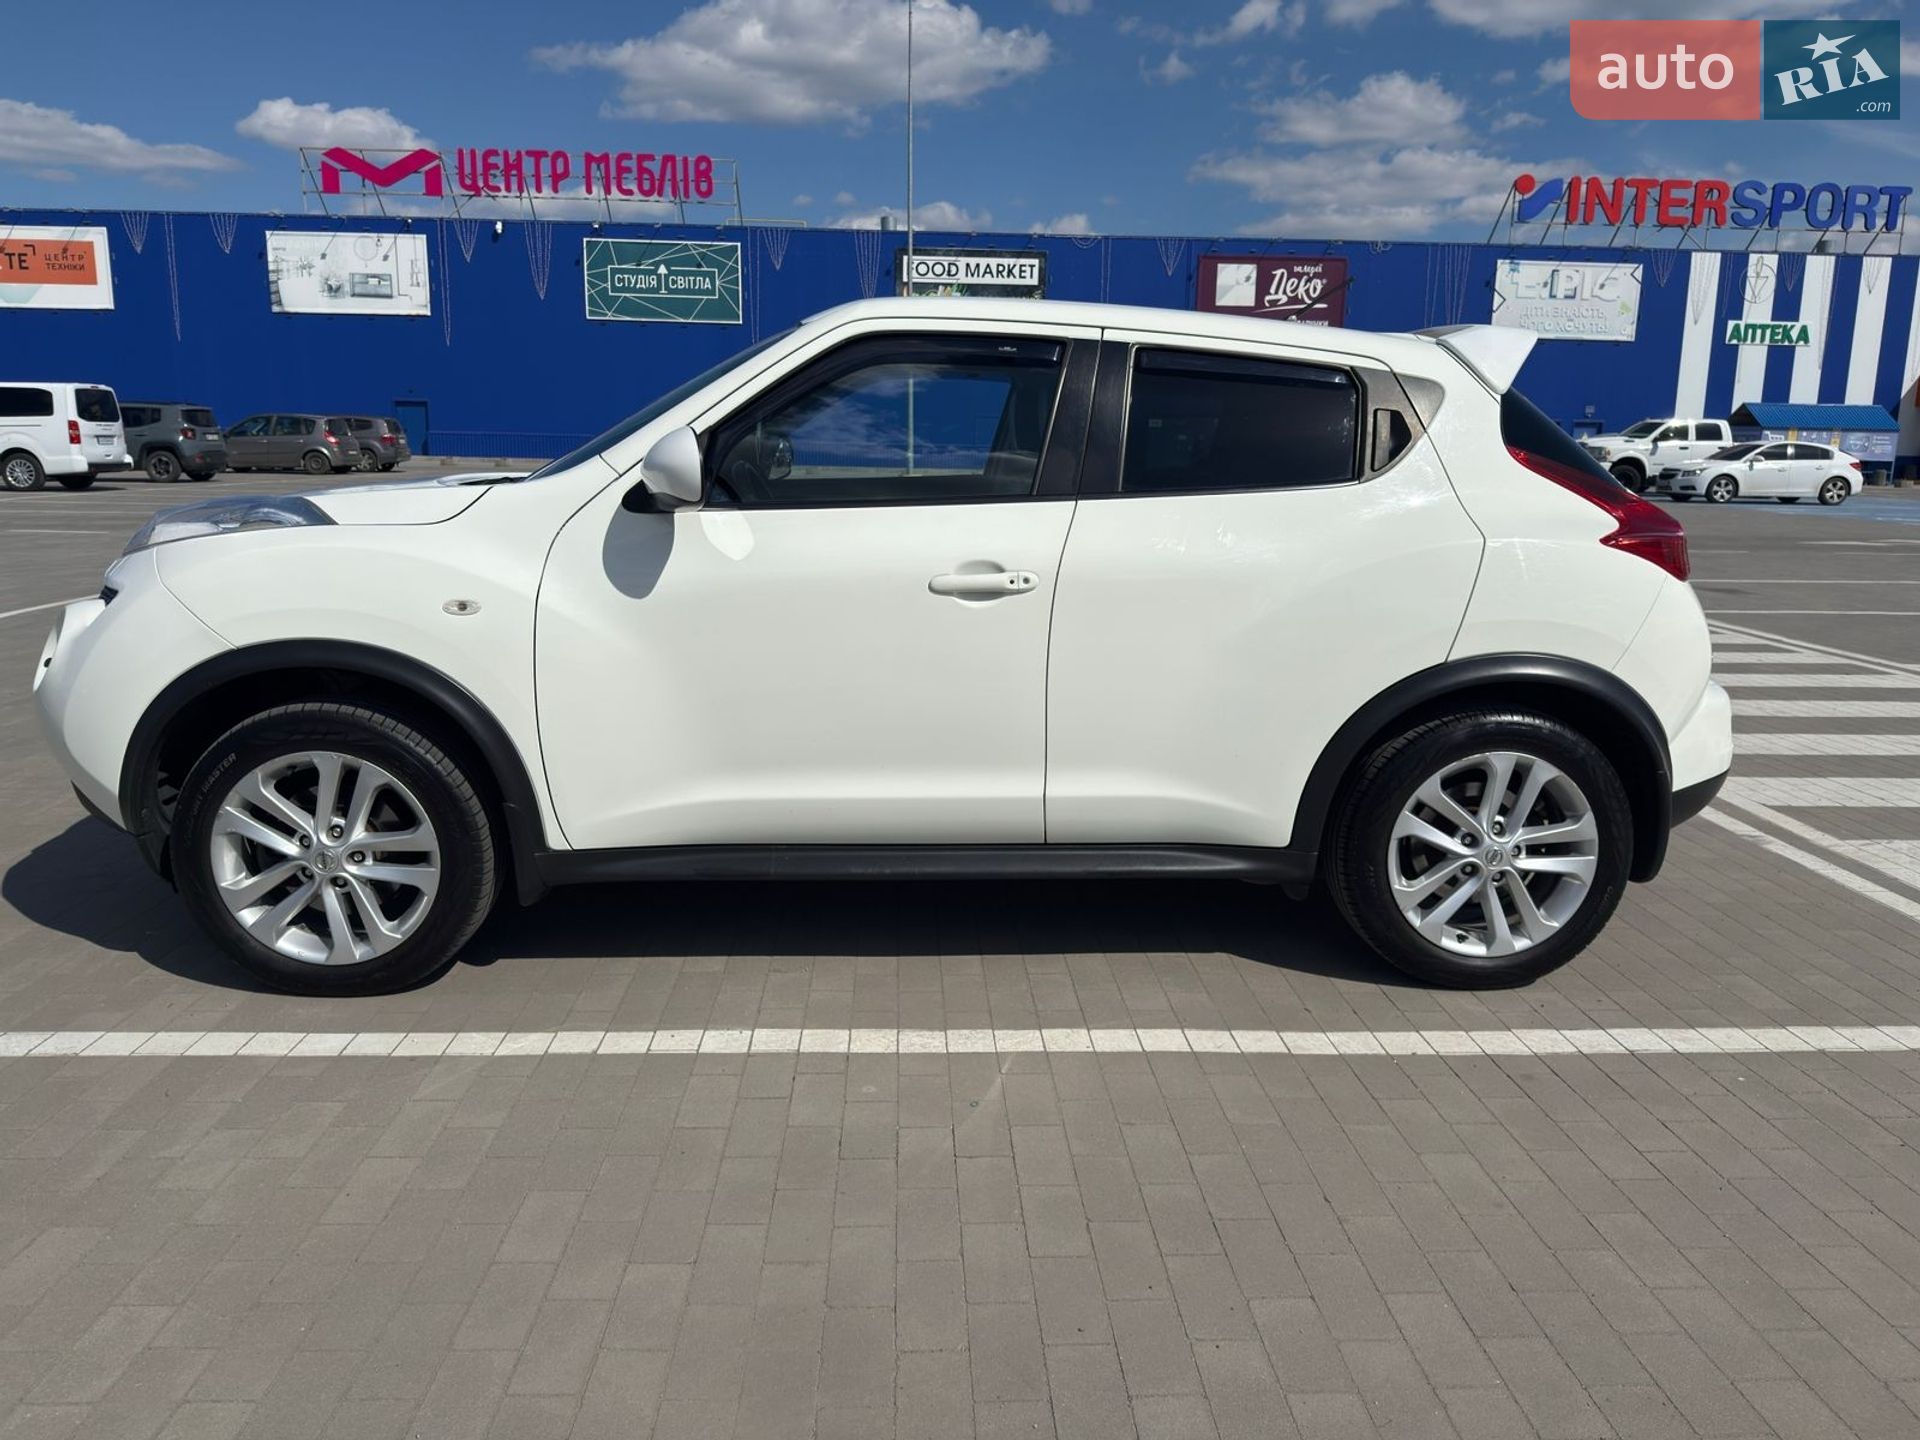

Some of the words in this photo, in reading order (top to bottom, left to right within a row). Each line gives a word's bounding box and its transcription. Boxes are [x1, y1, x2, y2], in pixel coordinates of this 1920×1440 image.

[457, 147, 570, 197] ЦЕНТР
[584, 151, 714, 199] МЕБЛІВ
[1566, 175, 1913, 232] INTERSPORT
[44, 252, 85, 262] ЦЕНТР
[45, 262, 86, 271] ТЕХНІКИ
[965, 262, 1036, 280] MARKET
[614, 274, 658, 289] СТУДІЯ
[668, 275, 712, 290] СВІТЛА
[1727, 322, 1810, 345] АПТЕКА
